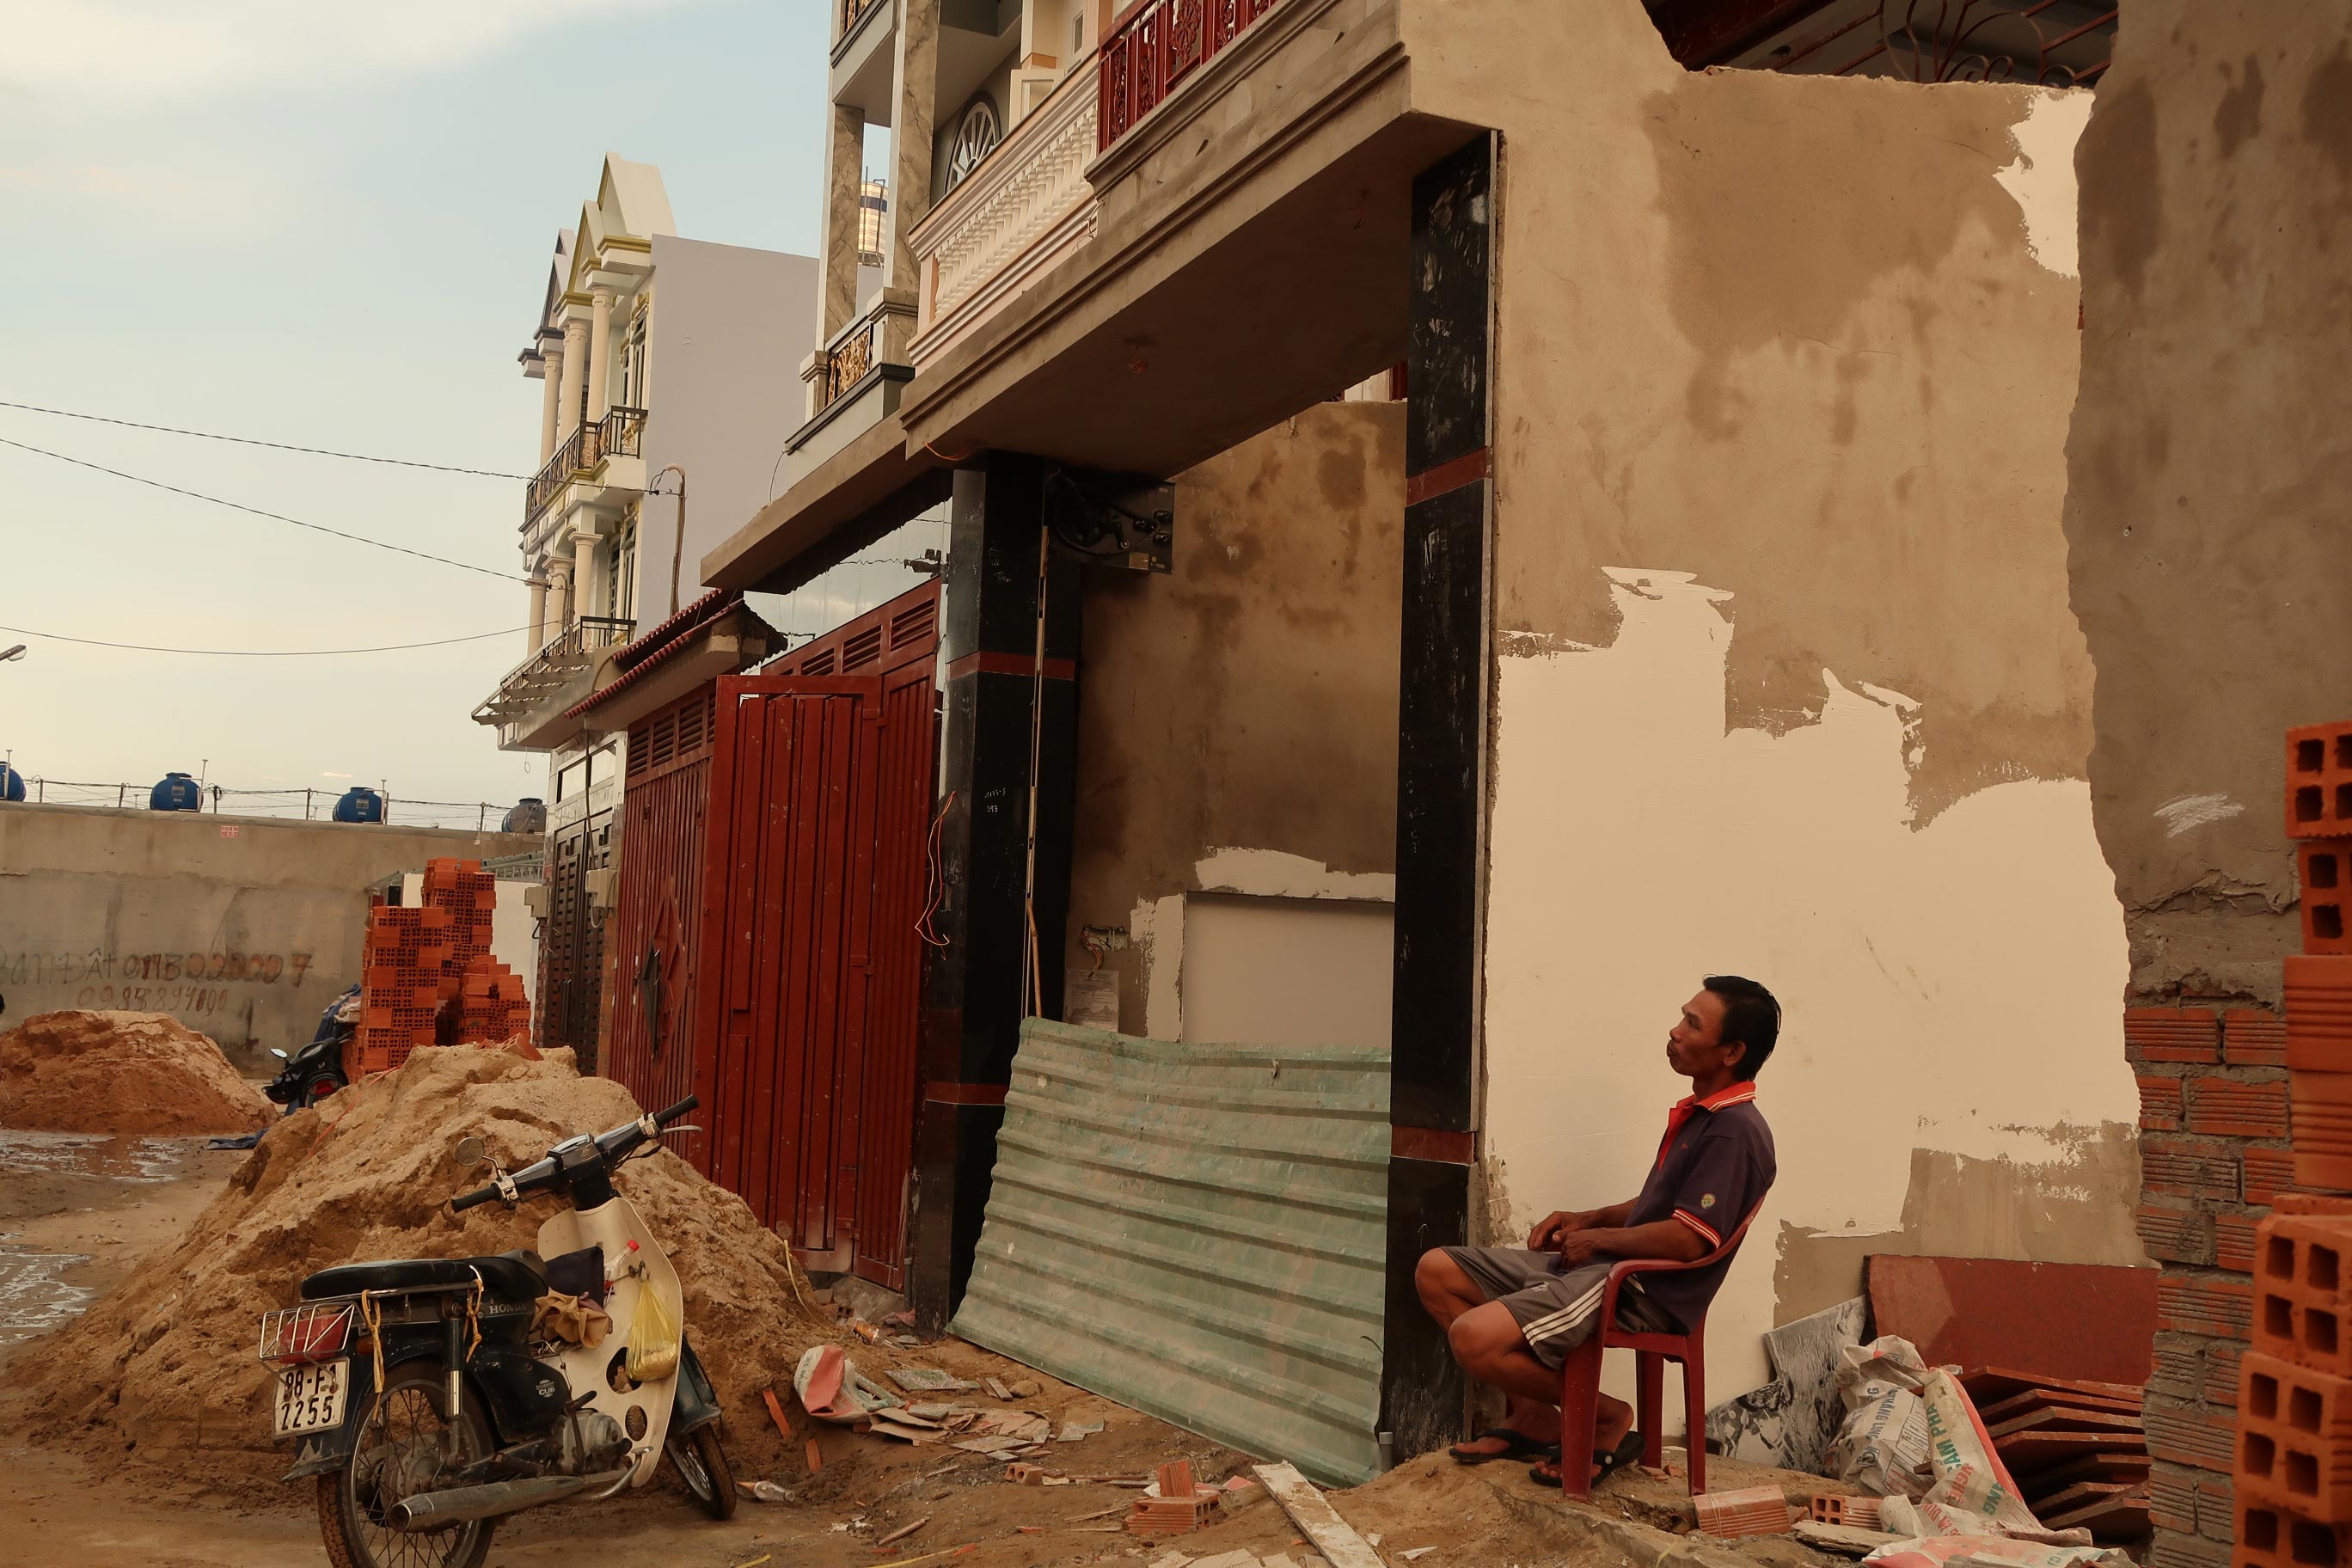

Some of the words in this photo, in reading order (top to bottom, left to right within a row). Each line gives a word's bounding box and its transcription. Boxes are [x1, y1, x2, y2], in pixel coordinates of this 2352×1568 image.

[489, 1303, 527, 1314] HONDA
[539, 1387, 555, 1395] CUB
[281, 1395, 334, 1430] 2255
